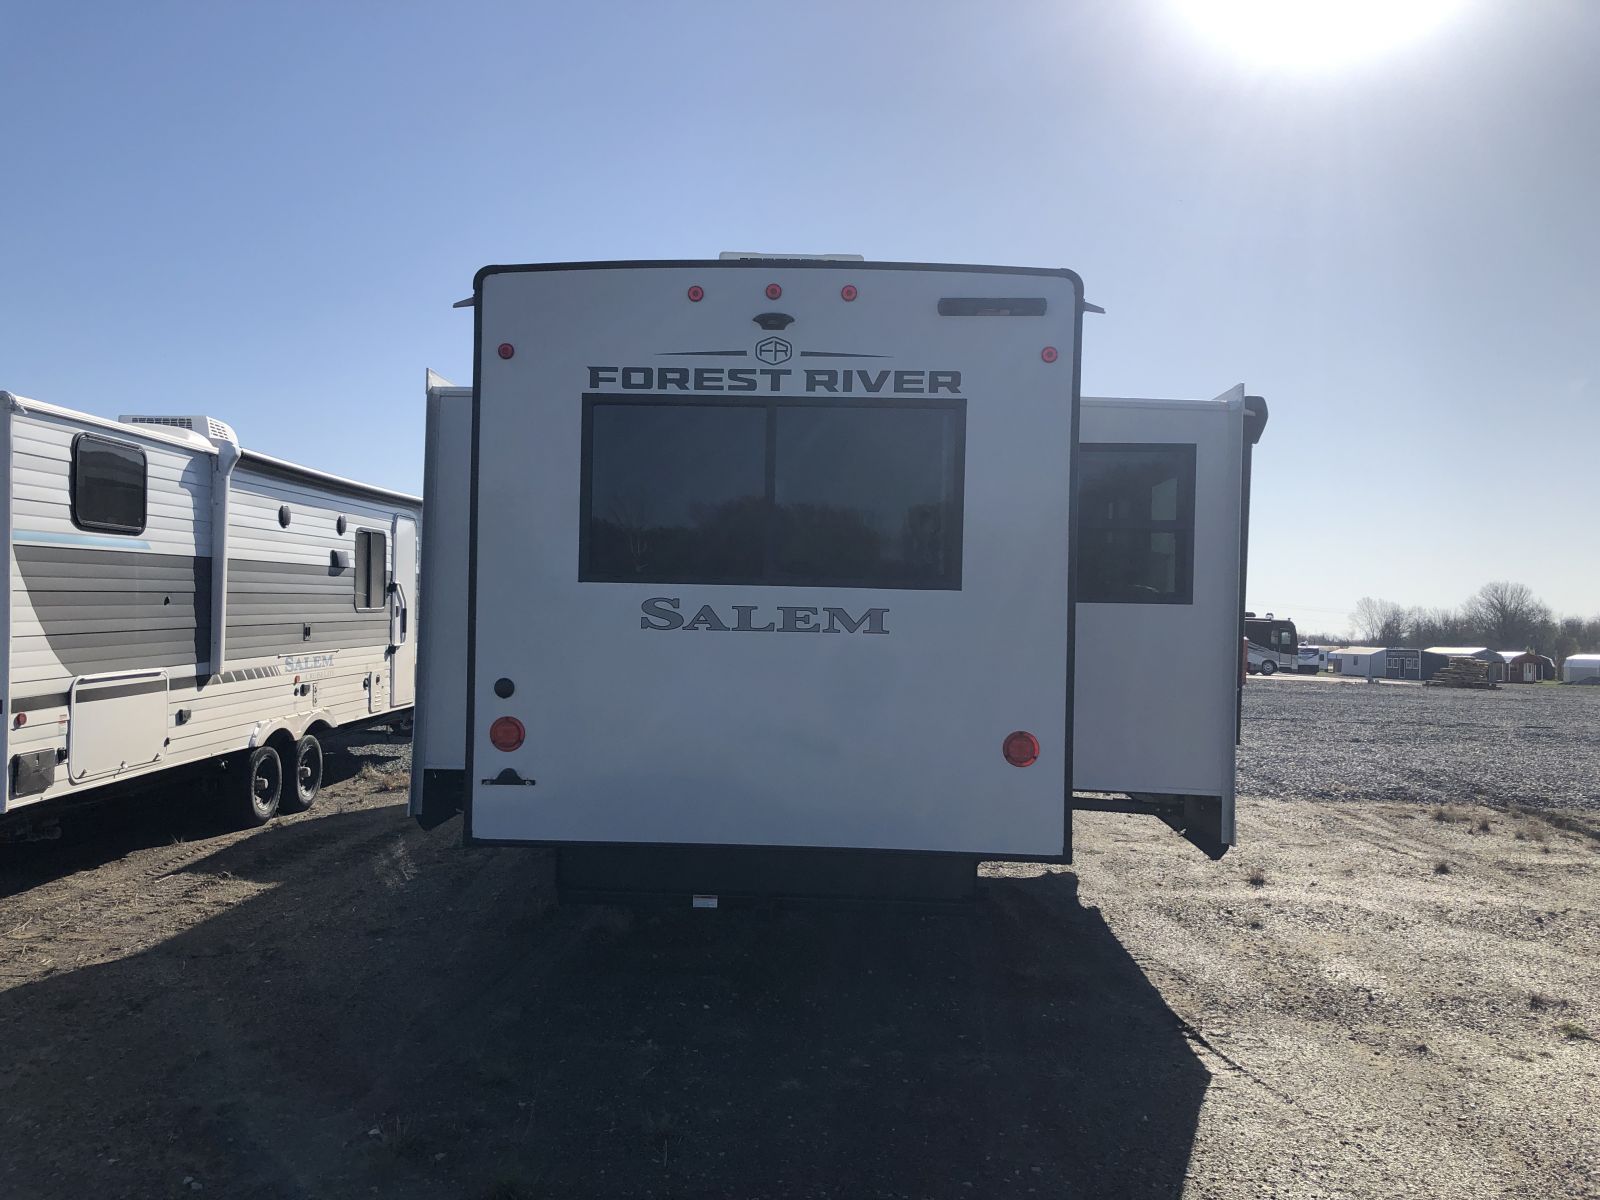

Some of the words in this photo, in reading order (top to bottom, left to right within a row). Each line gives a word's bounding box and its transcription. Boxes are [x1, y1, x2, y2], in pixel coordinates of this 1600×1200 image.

[758, 339, 790, 363] FR
[586, 366, 792, 392] FOREST
[803, 369, 962, 394] RIVER
[640, 597, 890, 634] SALEM
[285, 655, 334, 672] SALEM
